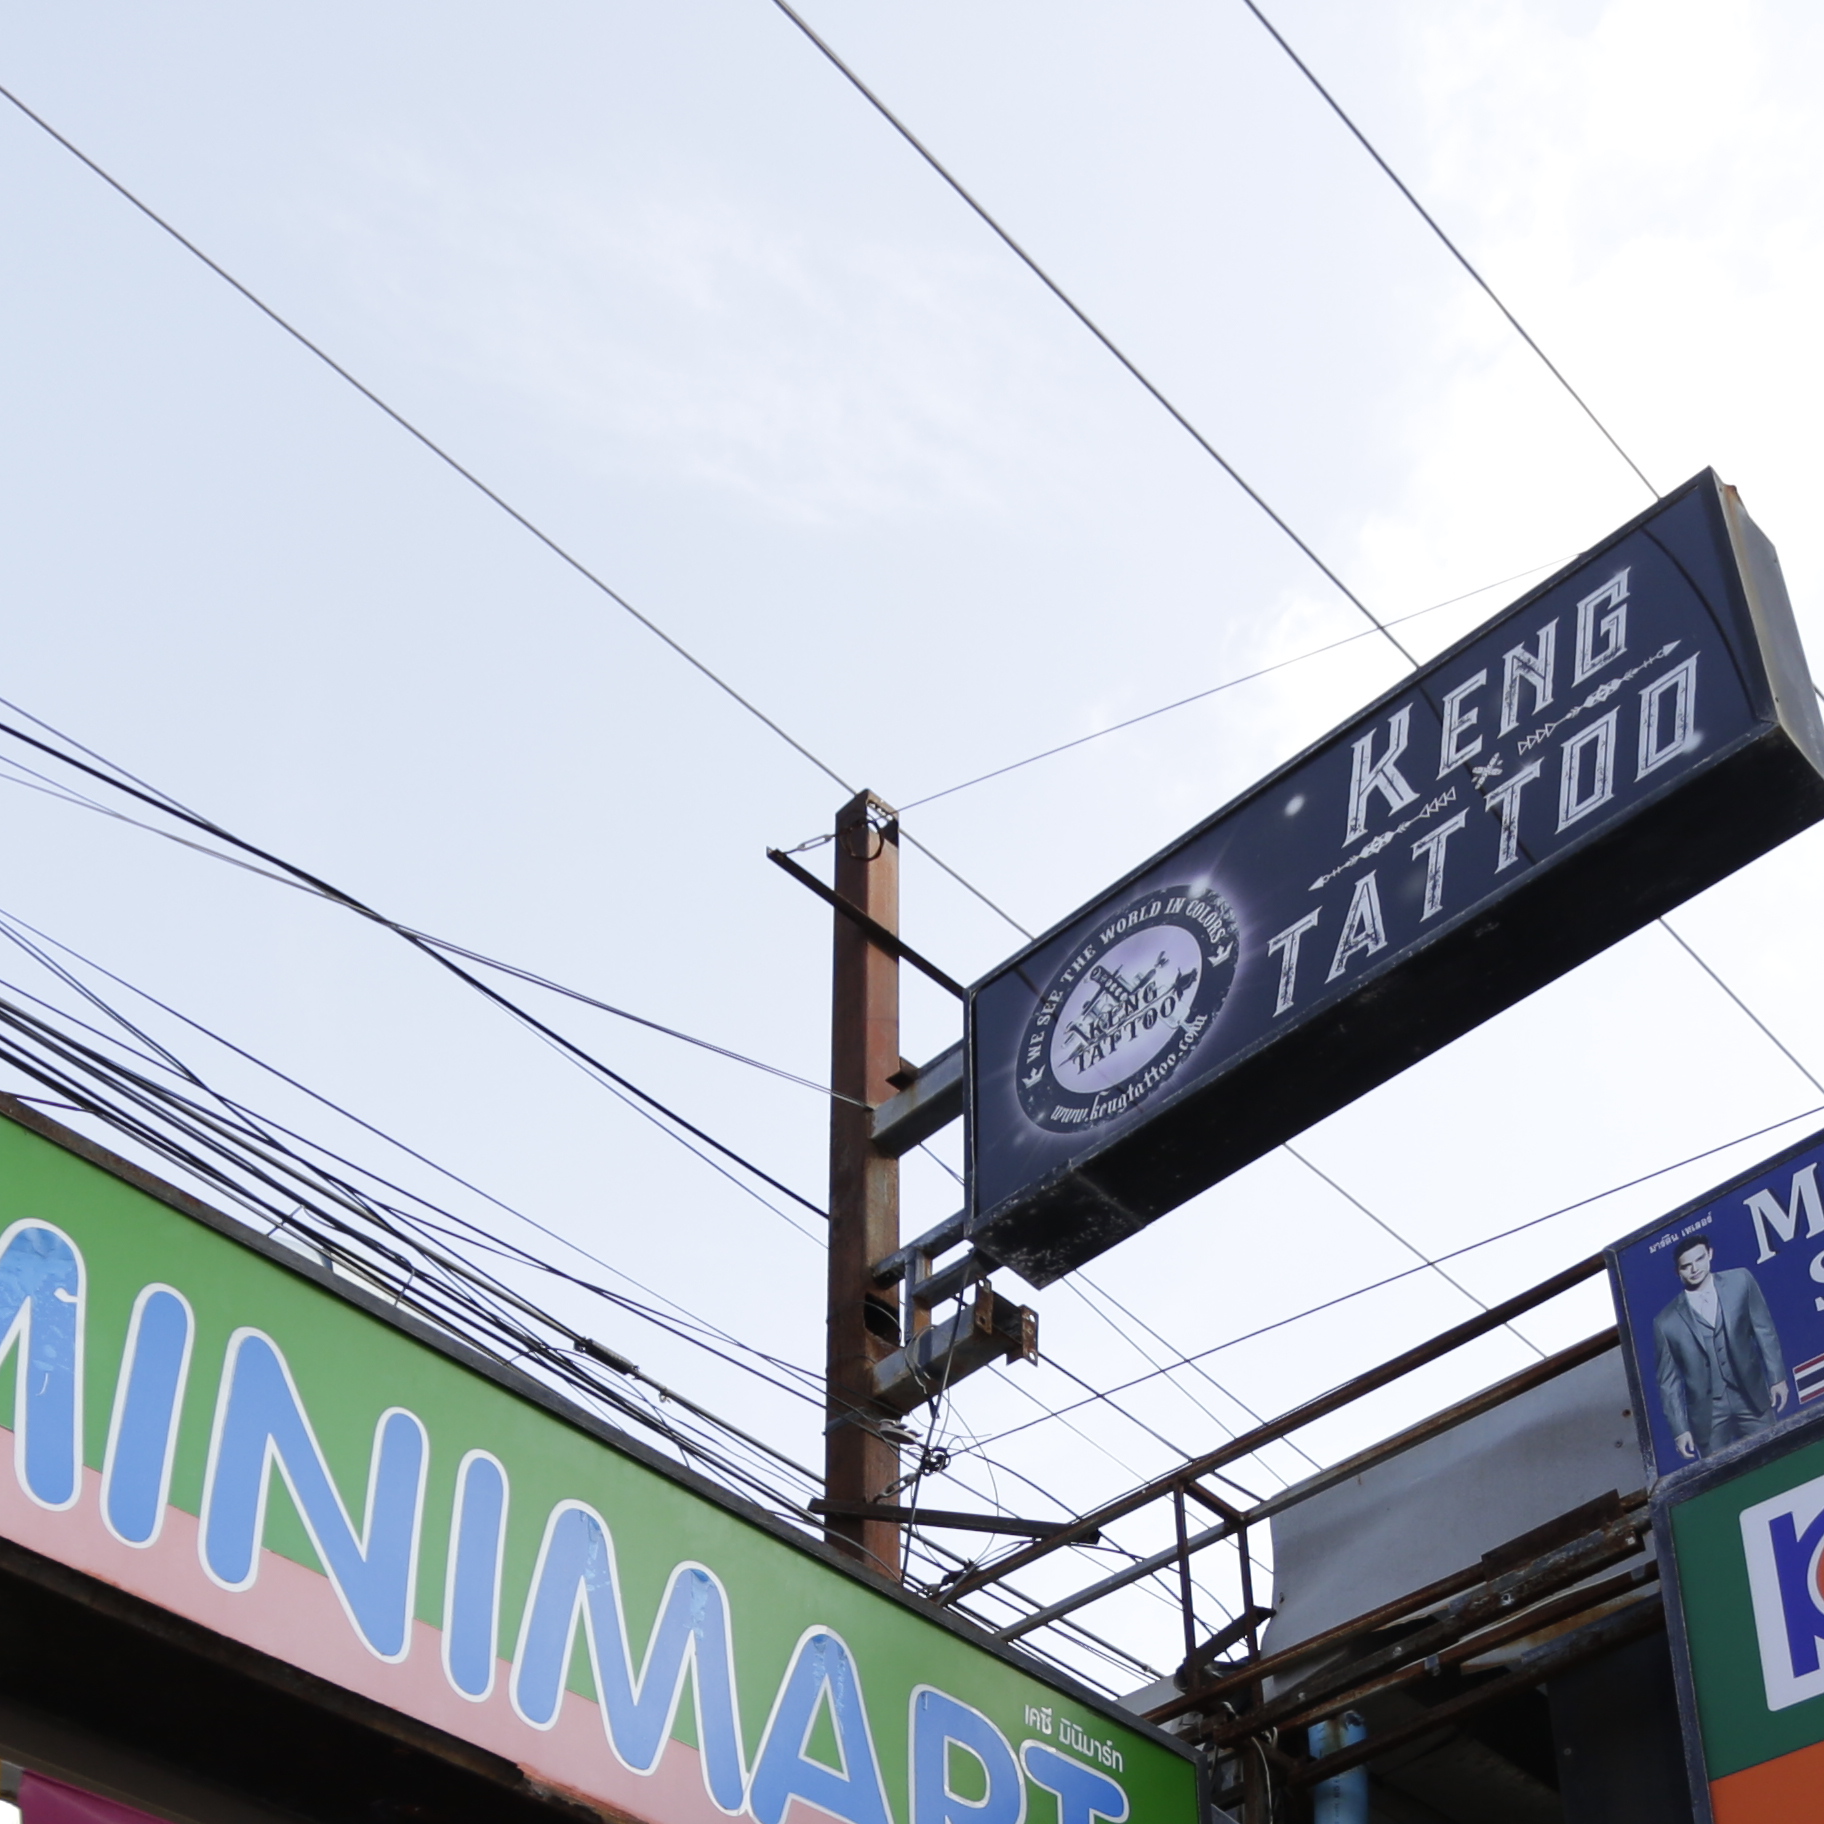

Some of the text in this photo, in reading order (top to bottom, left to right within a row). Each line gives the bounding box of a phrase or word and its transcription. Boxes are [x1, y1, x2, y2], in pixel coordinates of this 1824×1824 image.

[1267, 652, 1701, 1018] TATTOO
[1342, 566, 1631, 848] KENG
[1026, 897, 1227, 1064] WE SEE THE WORLD IN COLORS
